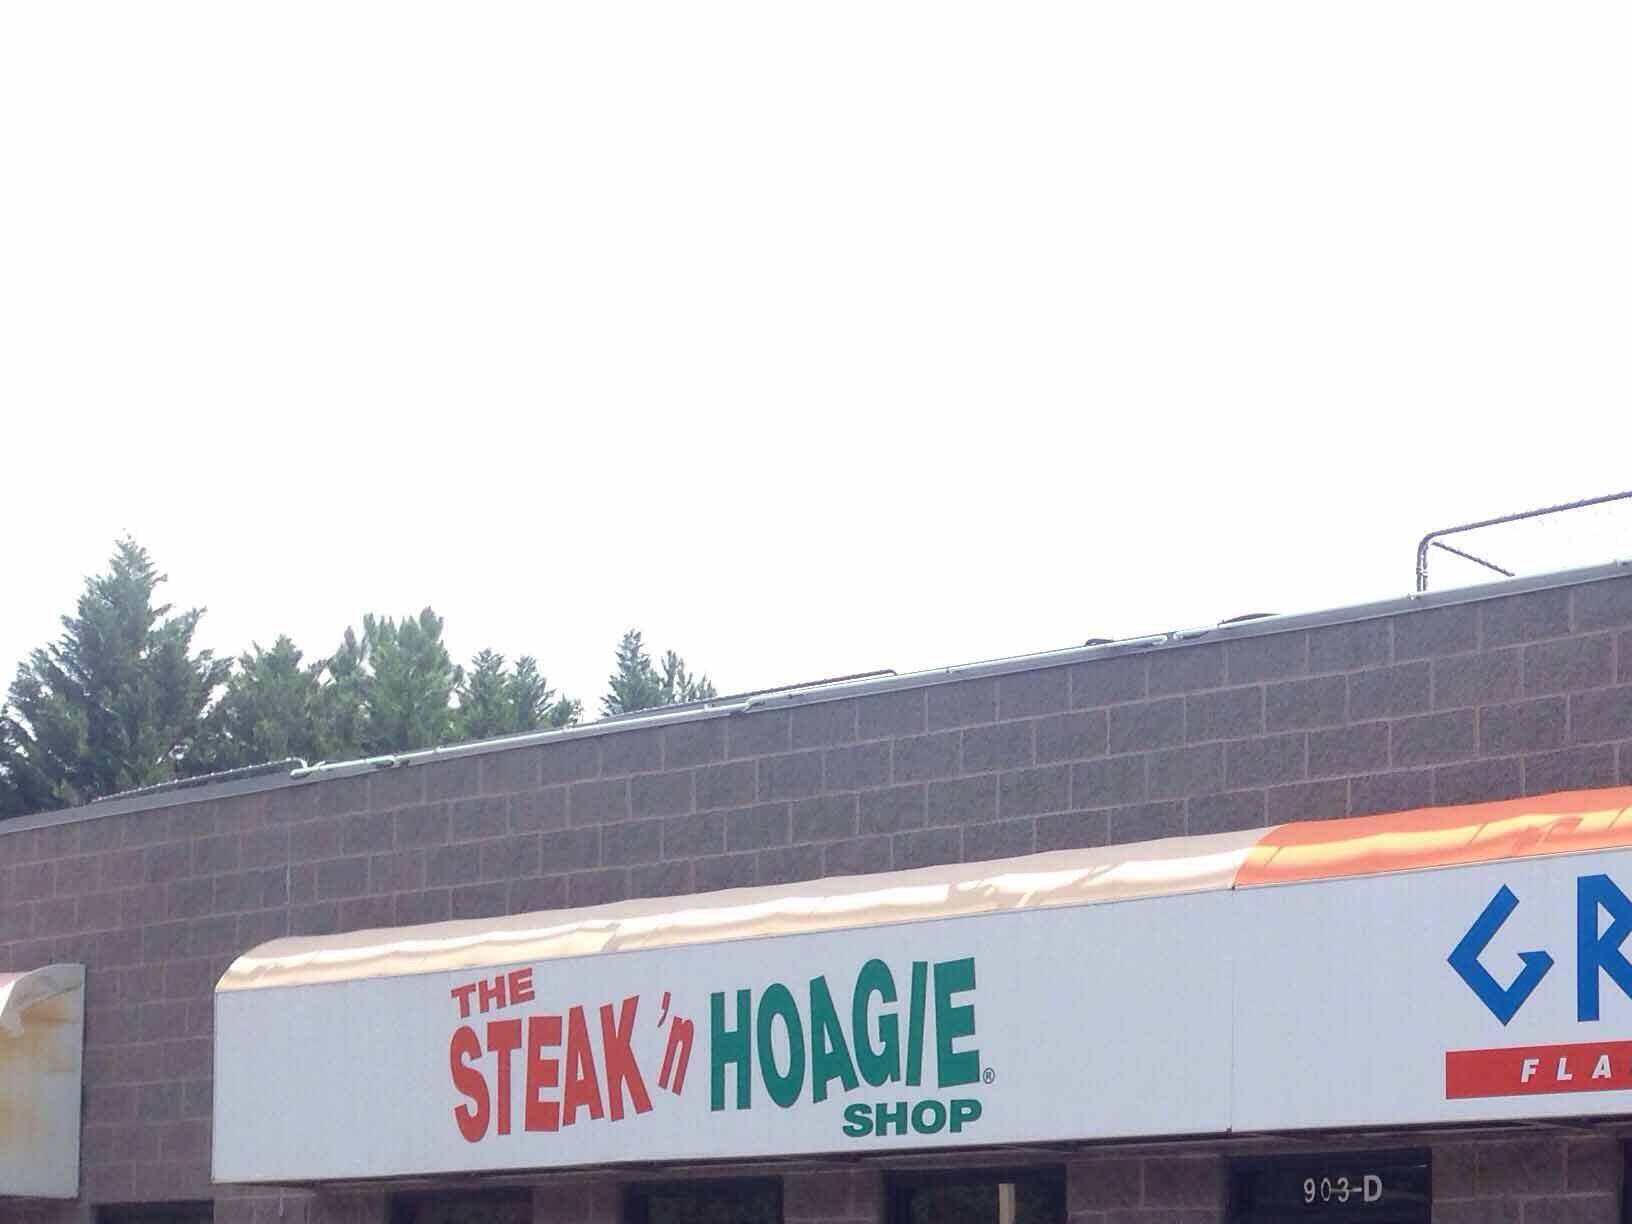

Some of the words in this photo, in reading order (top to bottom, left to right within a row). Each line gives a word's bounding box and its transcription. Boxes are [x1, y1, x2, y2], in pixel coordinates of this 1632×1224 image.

[451, 967, 536, 1018] THE
[710, 957, 981, 1111] HOAGIE
[843, 1098, 982, 1138] SHOP
